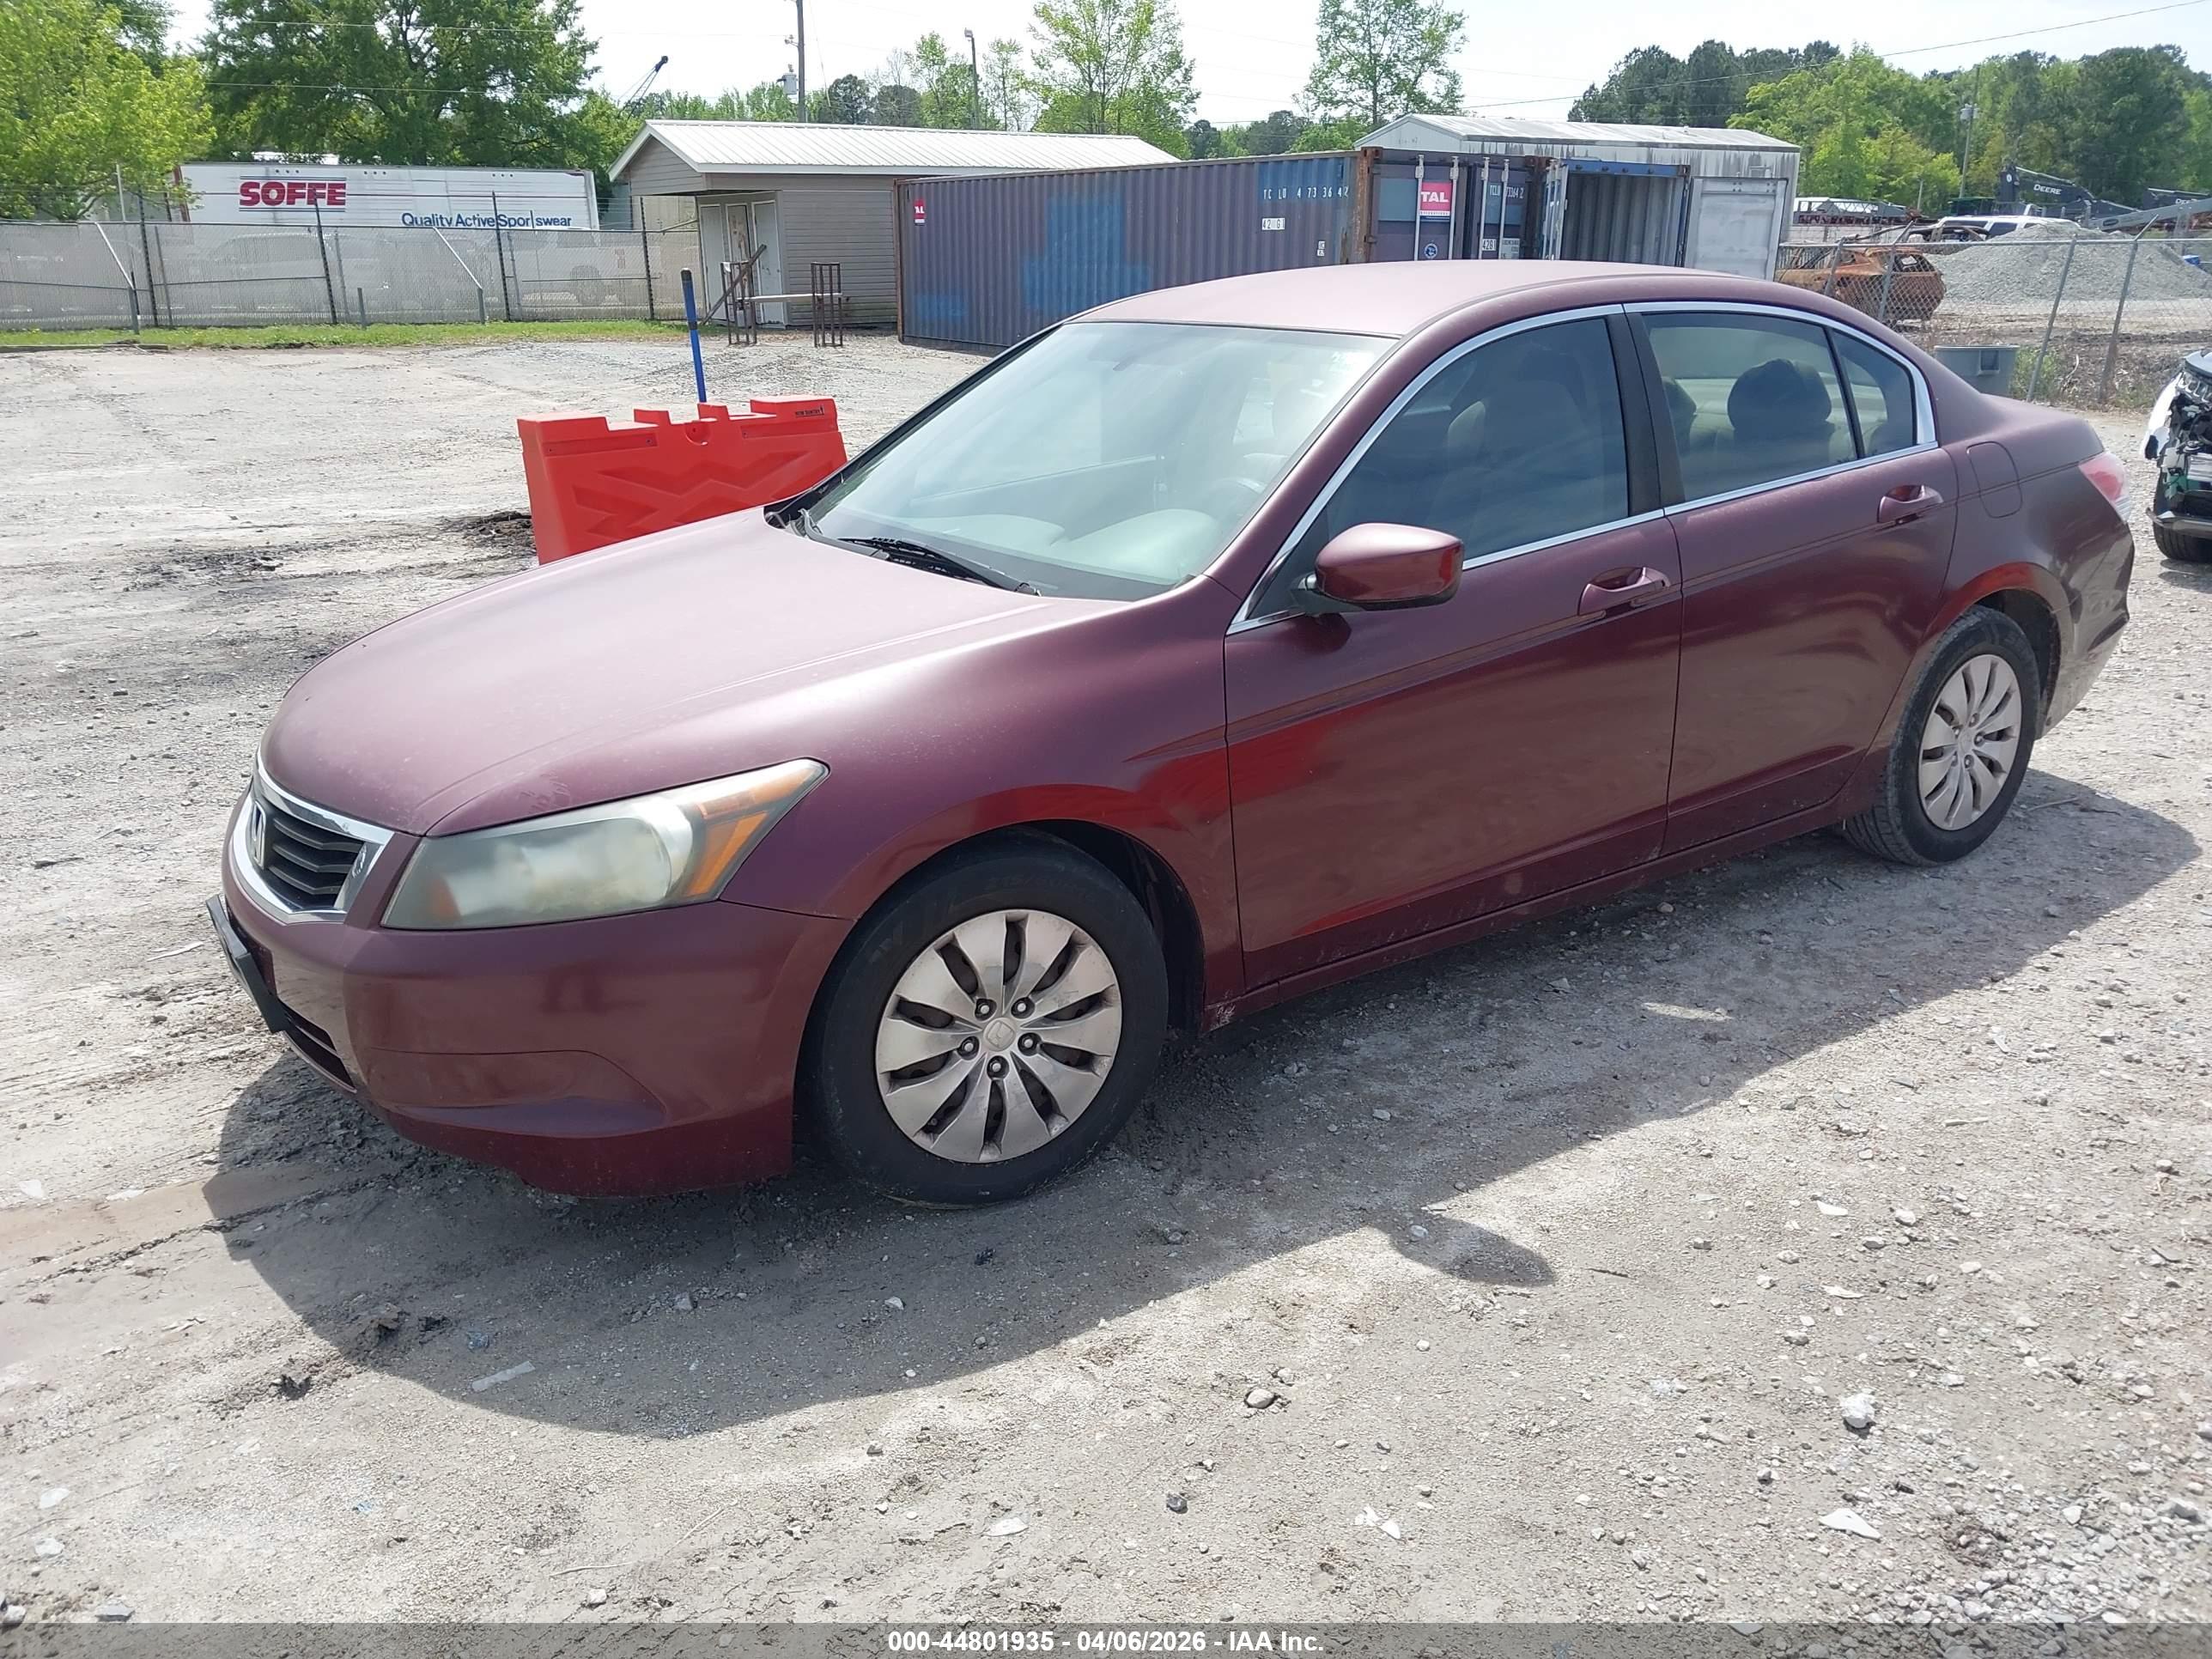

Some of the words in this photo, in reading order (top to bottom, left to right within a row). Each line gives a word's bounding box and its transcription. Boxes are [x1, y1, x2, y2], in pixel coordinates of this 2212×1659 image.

[240, 181, 346, 206] SOFFE
[2033, 184, 2063, 195] DEERE
[1420, 191, 1449, 203] TAL
[402, 212, 453, 227] Quality
[455, 214, 495, 227] Active
[497, 215, 572, 228] Sporswear
